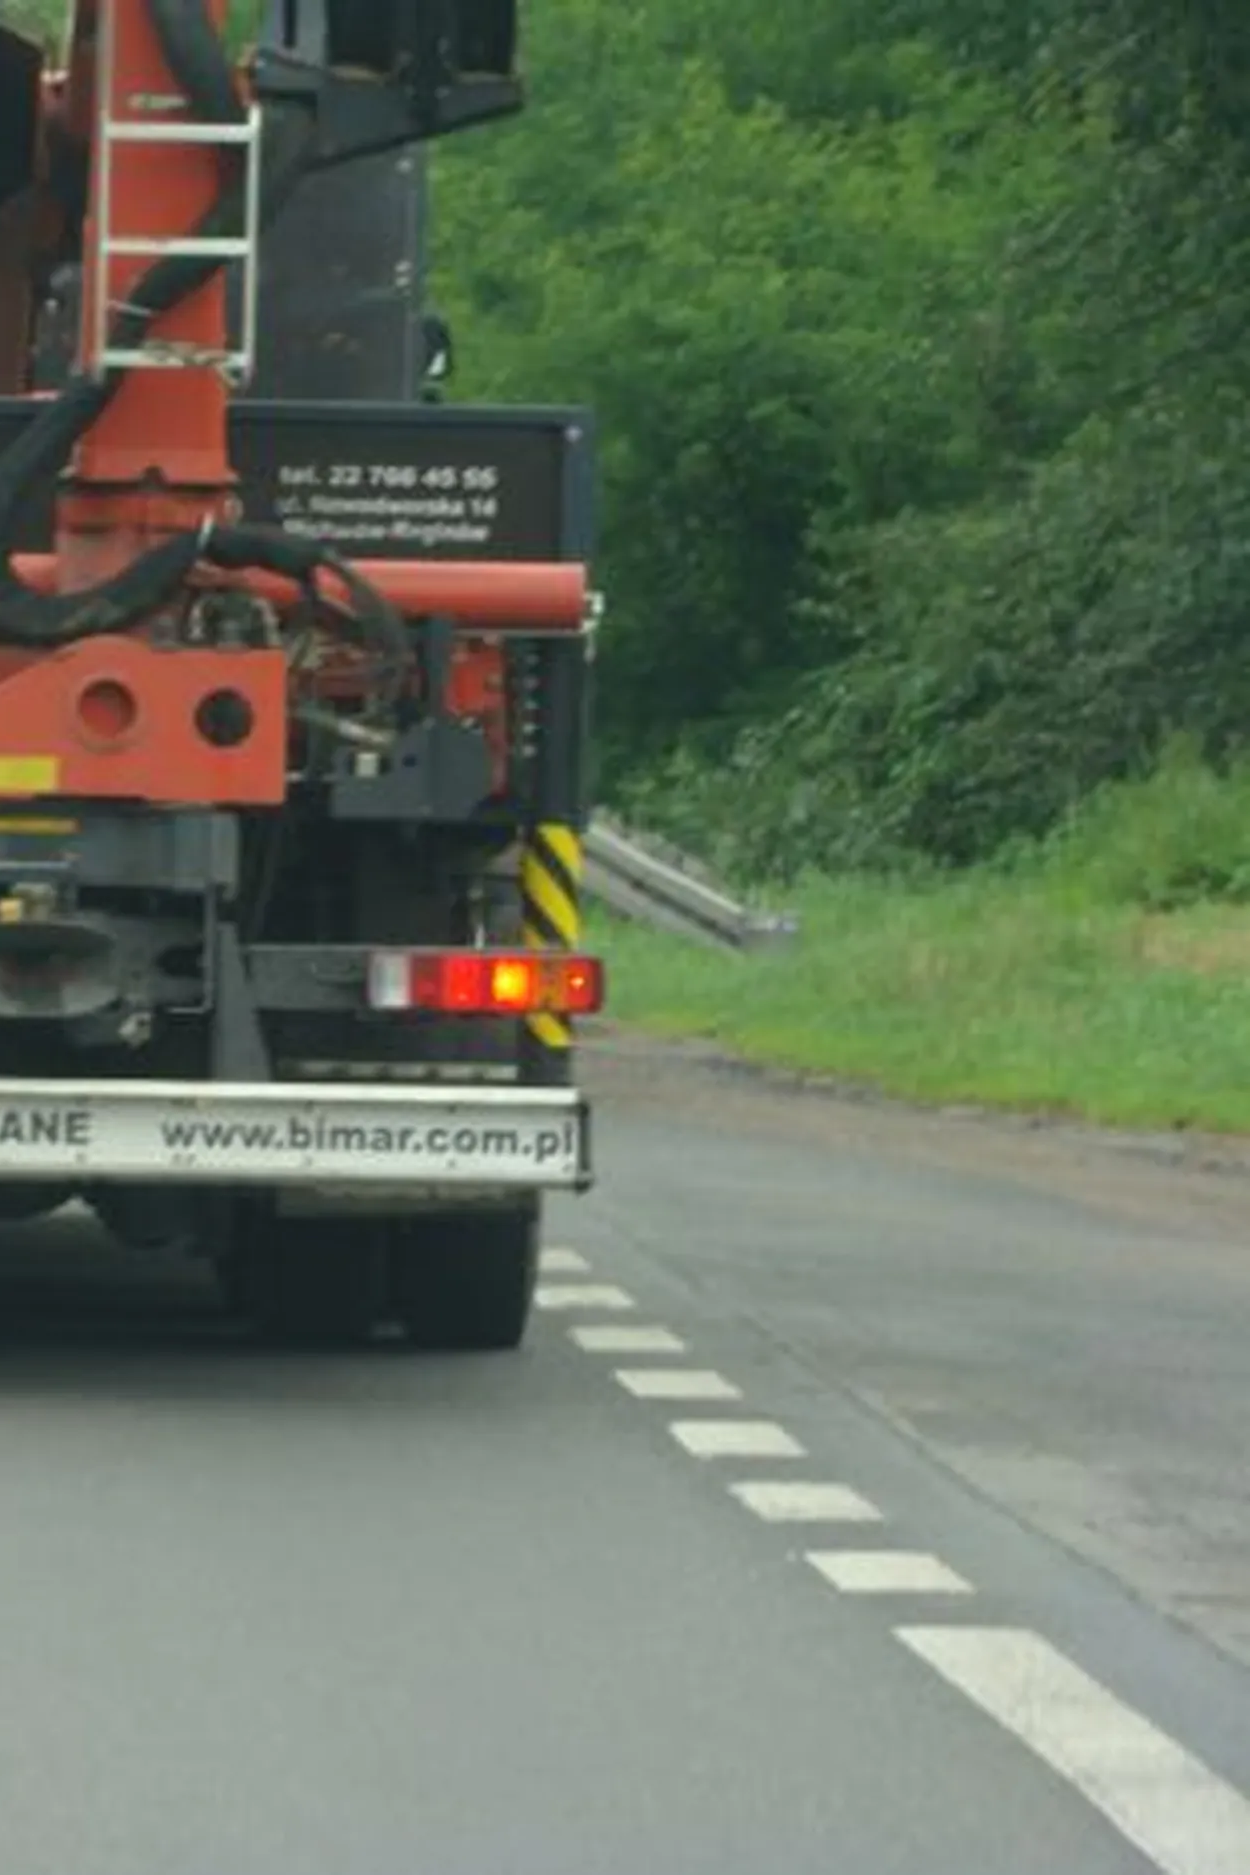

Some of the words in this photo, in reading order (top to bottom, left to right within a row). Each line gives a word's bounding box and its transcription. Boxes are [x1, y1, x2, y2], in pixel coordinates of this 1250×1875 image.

[279, 465, 322, 486] tel.
[329, 465, 361, 487] 22
[161, 1117, 575, 1162] www.bimar.com.pl
